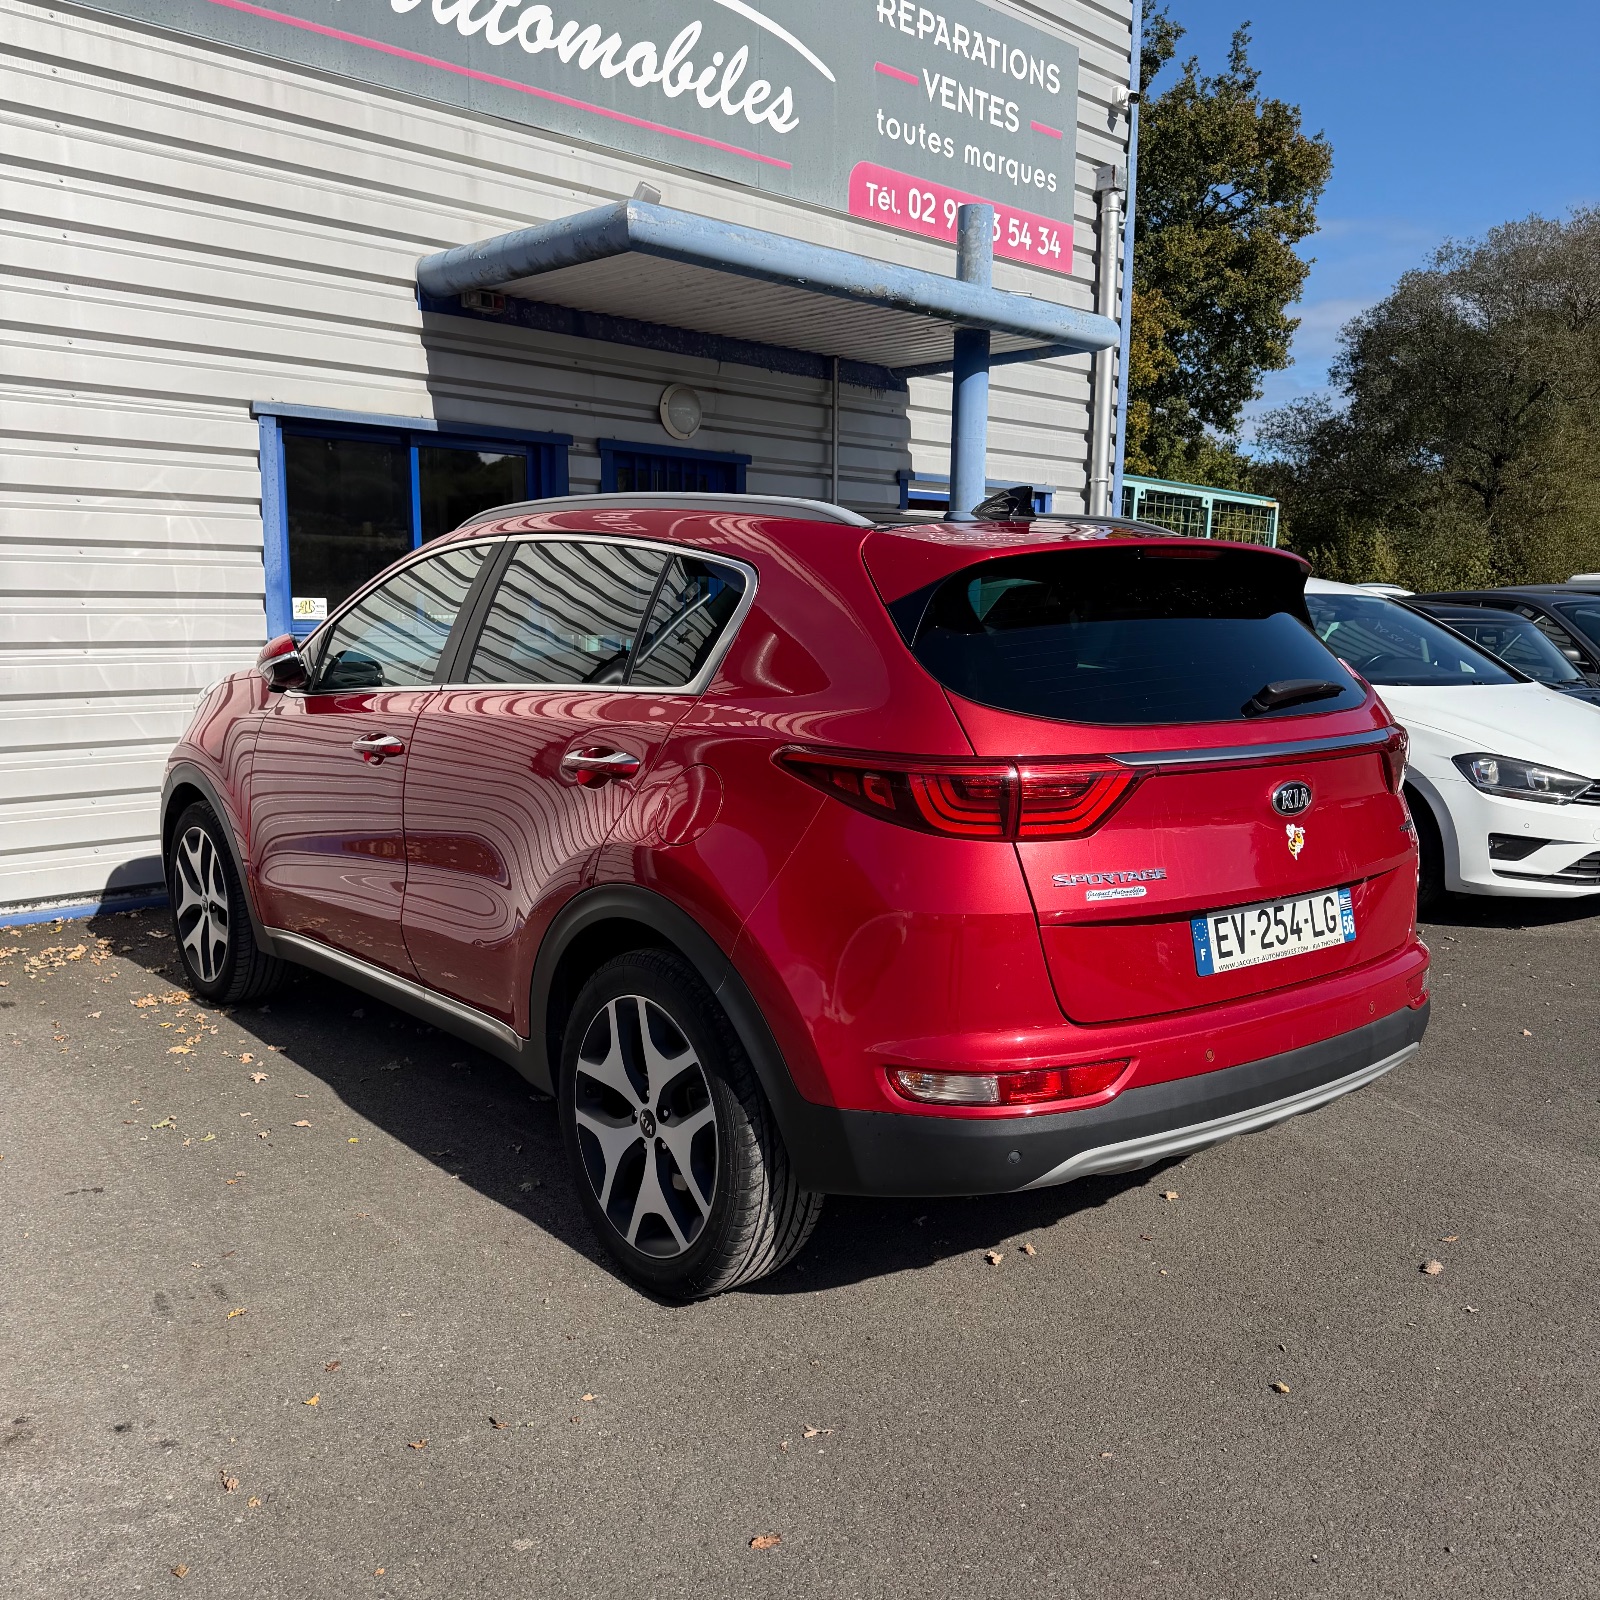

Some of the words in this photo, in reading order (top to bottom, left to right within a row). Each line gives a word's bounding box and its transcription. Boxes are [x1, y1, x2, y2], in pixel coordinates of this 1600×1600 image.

[391, 0, 799, 133] utomobiles
[923, 68, 1020, 132] VENTES
[877, 109, 954, 158] toutes
[964, 144, 1057, 192] marques
[866, 182, 901, 214] Tél.
[908, 188, 936, 224] 02
[943, 198, 965, 230] 9
[1007, 217, 1032, 250] 54
[1037, 226, 1062, 258] 34
[1281, 788, 1309, 810] KIA
[1052, 868, 1168, 888] SPORTAGE
[1213, 896, 1338, 960] EV-254-LG
[1342, 914, 1354, 935] 56
[1200, 948, 1207, 961] F
[640, 1112, 653, 1135] KIA
